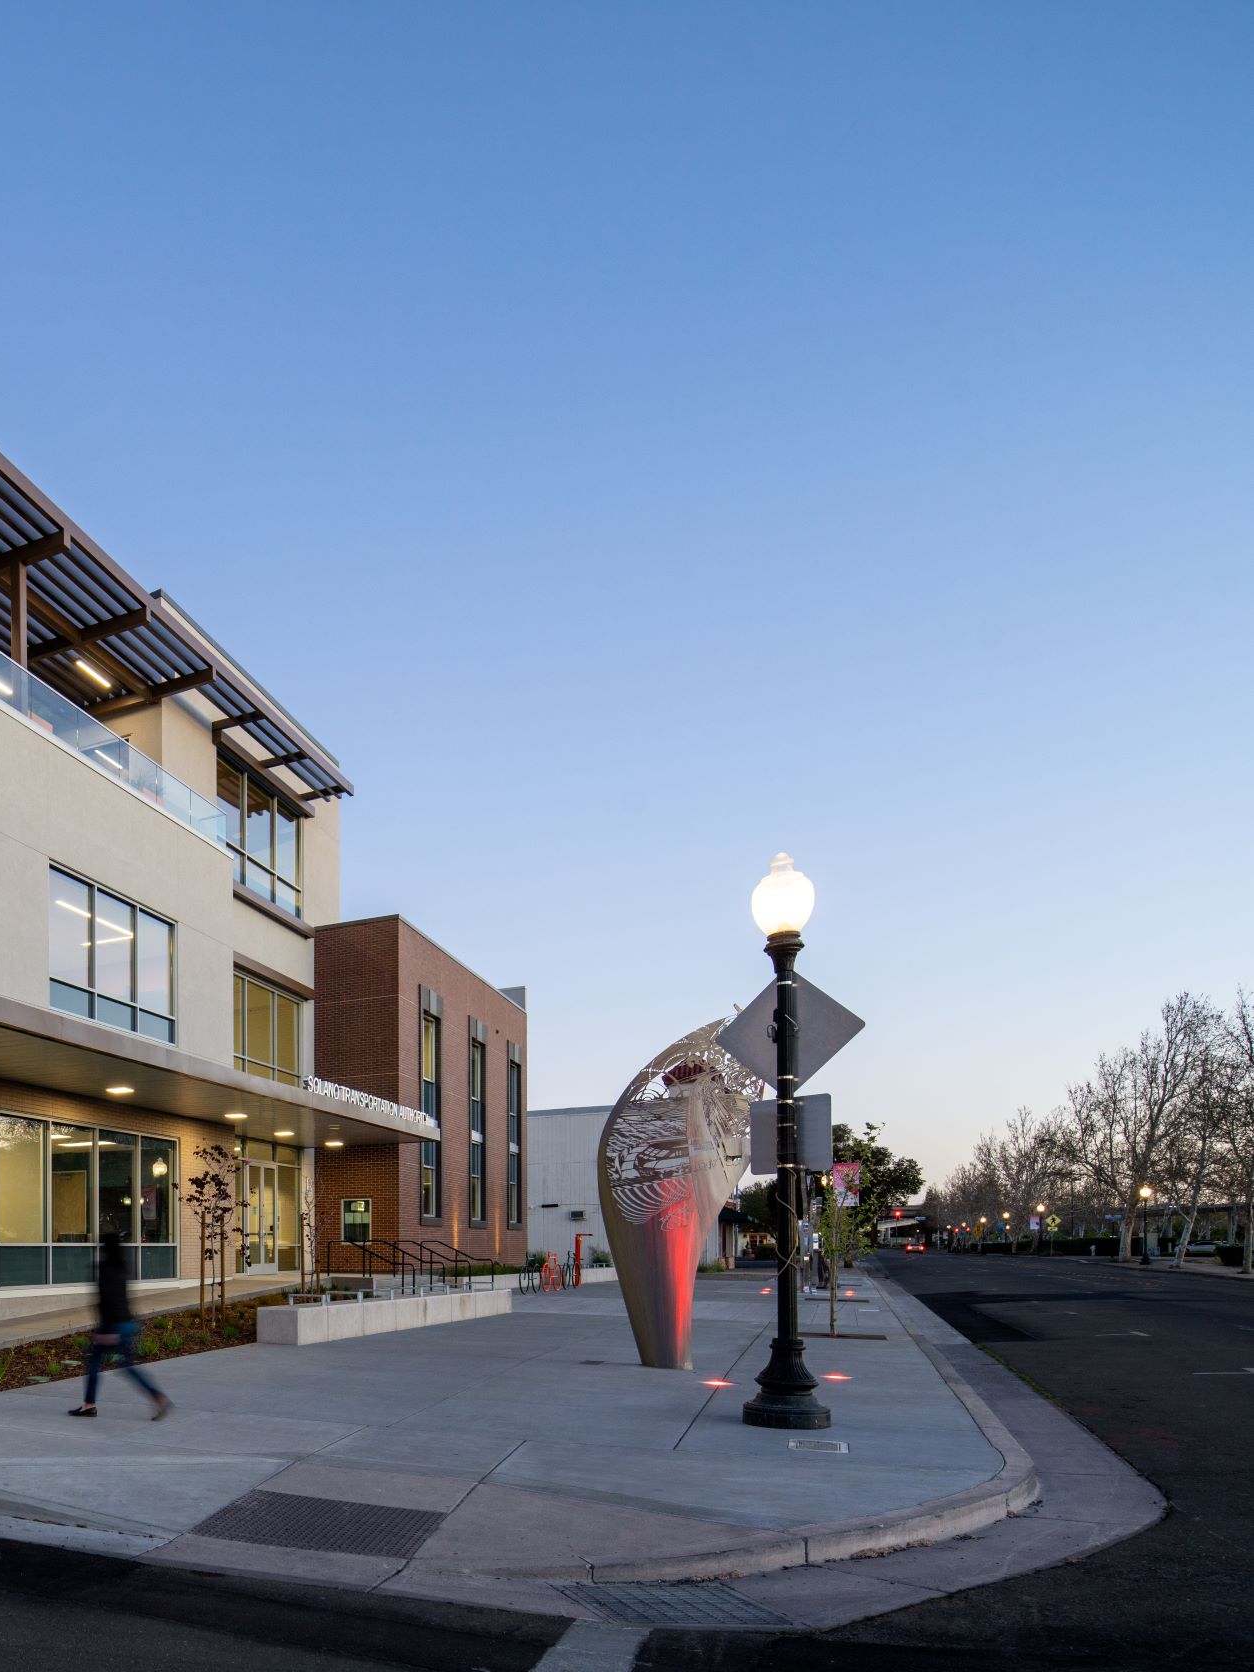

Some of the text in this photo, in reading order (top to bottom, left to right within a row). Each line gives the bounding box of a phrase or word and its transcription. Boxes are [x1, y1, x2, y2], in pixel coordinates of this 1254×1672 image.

[308, 1075, 429, 1126] SOLANO TRANSPORTATION AUTHORITY
